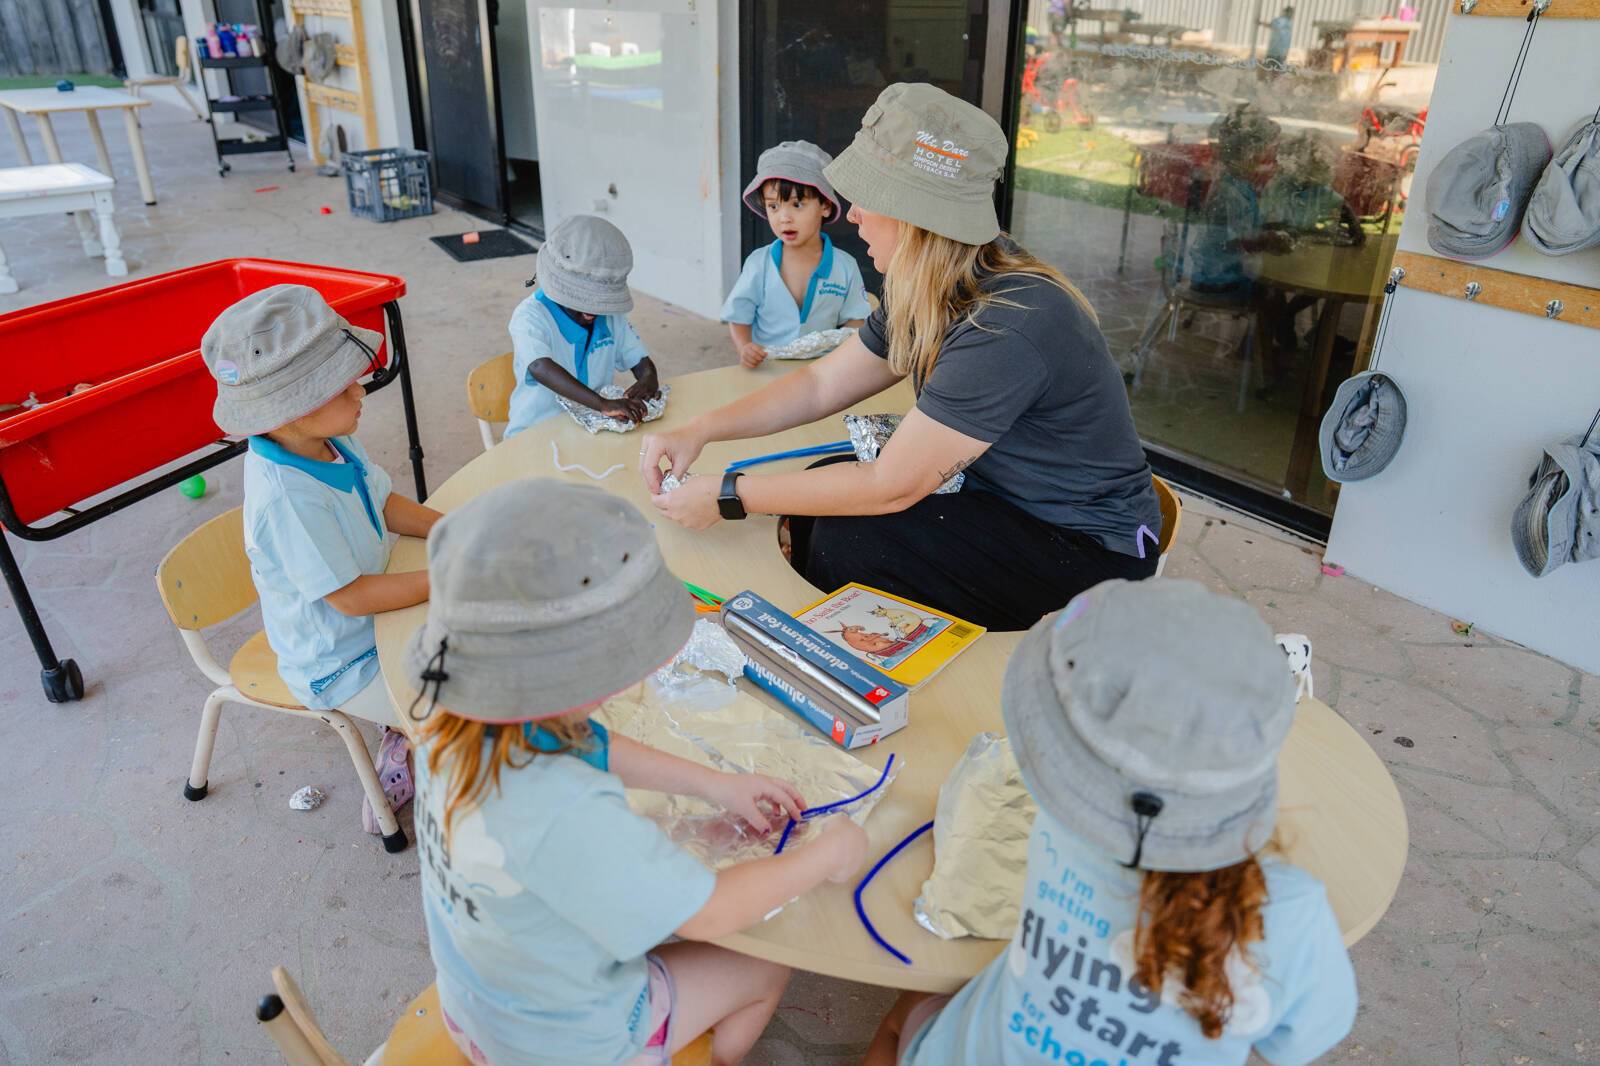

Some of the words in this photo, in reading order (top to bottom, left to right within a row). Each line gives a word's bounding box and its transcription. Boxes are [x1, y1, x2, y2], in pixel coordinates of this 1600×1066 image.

[915, 147, 962, 168] HOTEL
[757, 612, 781, 630] foil
[779, 622, 849, 671] aluminium
[1060, 867, 1095, 900] I'm
[1037, 880, 1110, 938] getting
[1057, 919, 1069, 935] a
[1021, 908, 1162, 1014] flying
[1021, 991, 1046, 1023] for
[1049, 984, 1182, 1066] start
[1008, 1011, 1128, 1066] scho
